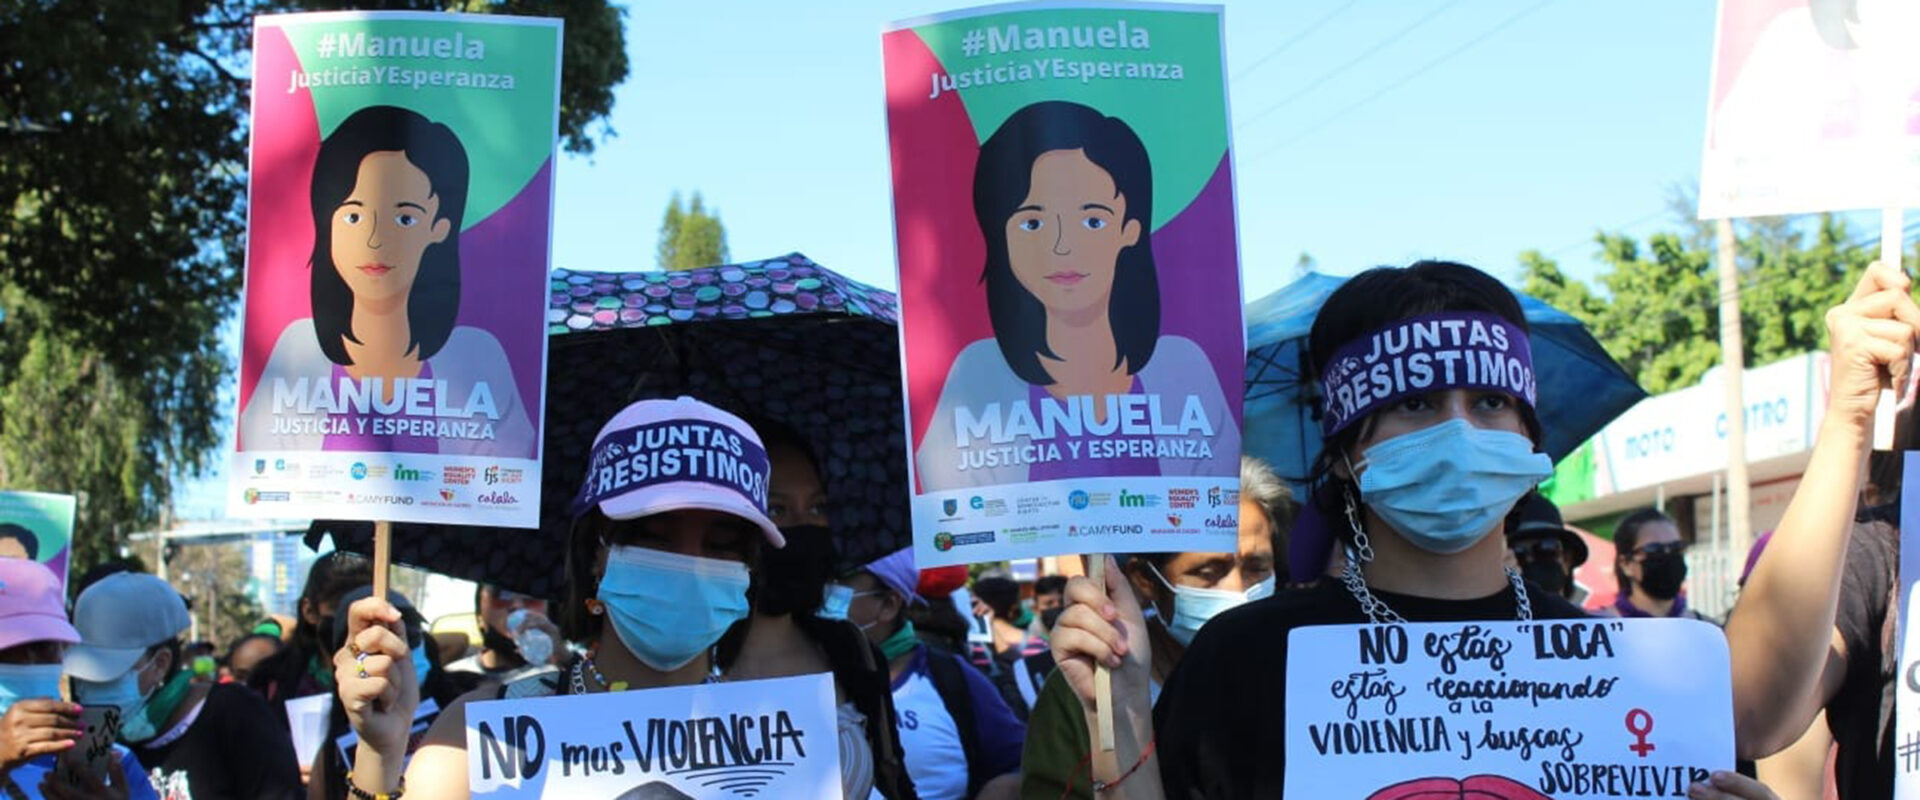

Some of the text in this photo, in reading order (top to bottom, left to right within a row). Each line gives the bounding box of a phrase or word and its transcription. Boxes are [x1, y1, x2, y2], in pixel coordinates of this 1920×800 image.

[318, 31, 485, 60] #Manuela
[962, 20, 1150, 57] #Manuela
[288, 66, 515, 94] JusticiaYEsperanza
[929, 58, 1184, 99] JusticiaYEsperanza
[1364, 320, 1509, 364] JUNTAS
[272, 377, 499, 420] MANUELA
[1336, 349, 1534, 420] RESISTIMOS
[271, 417, 495, 440] JUSTICIA Y ESPERANZA
[955, 394, 1214, 447] MANUELA
[627, 425, 742, 457] JUNTAS
[957, 439, 1213, 470] JUSTICIA Y ESPERANZA
[394, 463, 419, 481] im
[596, 449, 762, 502] RESISTIMOS
[1119, 489, 1145, 507] im
[1359, 625, 1408, 664] NO
[1427, 672, 1619, 707] reaccionando
[1449, 700, 1494, 714] a la
[478, 710, 806, 780] NO mas VIOLENCIA
[1309, 716, 1583, 761] VIOLENCIA y buscas
